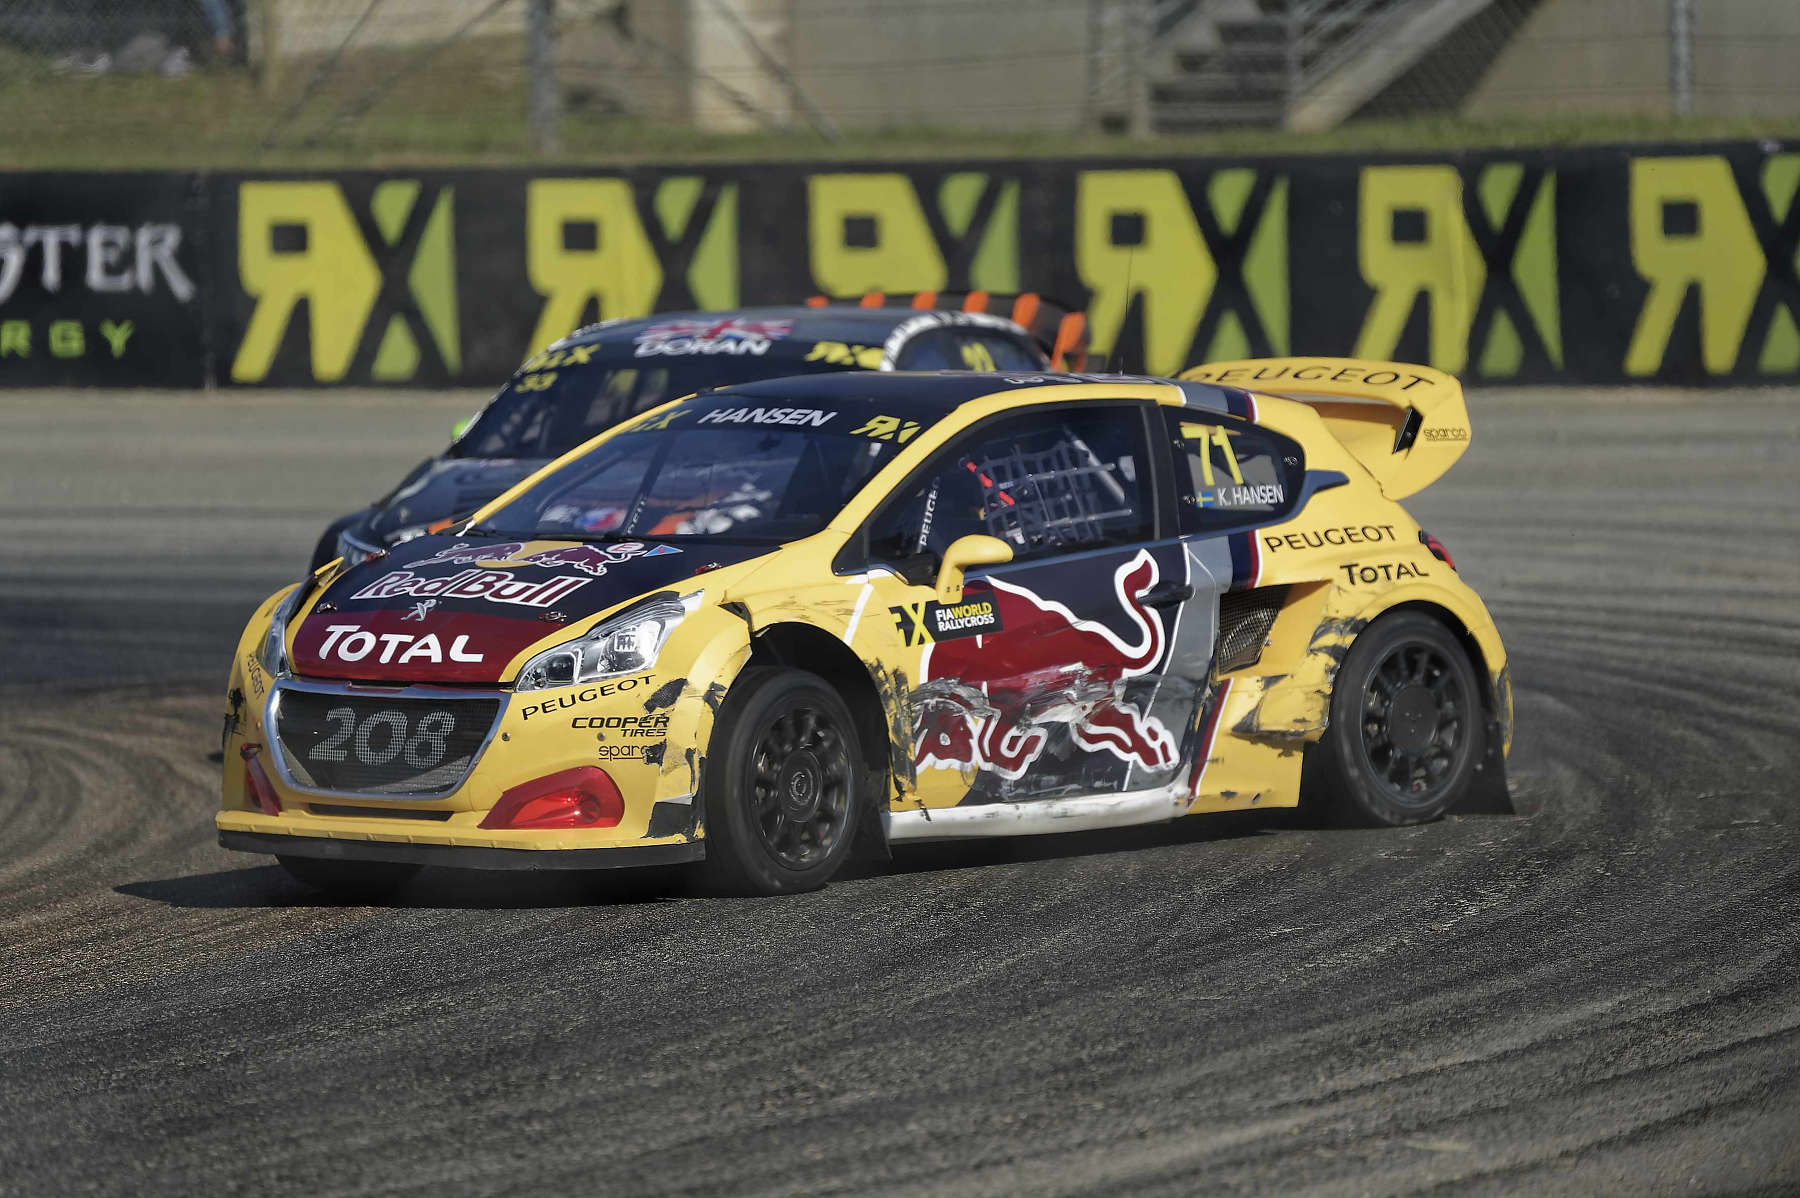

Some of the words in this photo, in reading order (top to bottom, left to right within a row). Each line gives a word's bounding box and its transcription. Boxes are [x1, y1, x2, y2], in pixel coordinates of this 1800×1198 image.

[634, 337, 772, 358] DORAN
[697, 408, 838, 427] HANSEN
[1181, 425, 1244, 486] 71
[1217, 486, 1232, 506] K.
[1232, 483, 1285, 505] HANSEN
[1264, 524, 1397, 553] PEUGEOT
[1340, 561, 1430, 587] TOTAL
[938, 613, 995, 632] RALLYCROSS
[318, 624, 485, 665] TOTAL
[521, 674, 657, 721] PEUGEOT
[571, 716, 670, 729] COOPER
[620, 728, 668, 738] TIRES
[308, 706, 457, 769] 208
